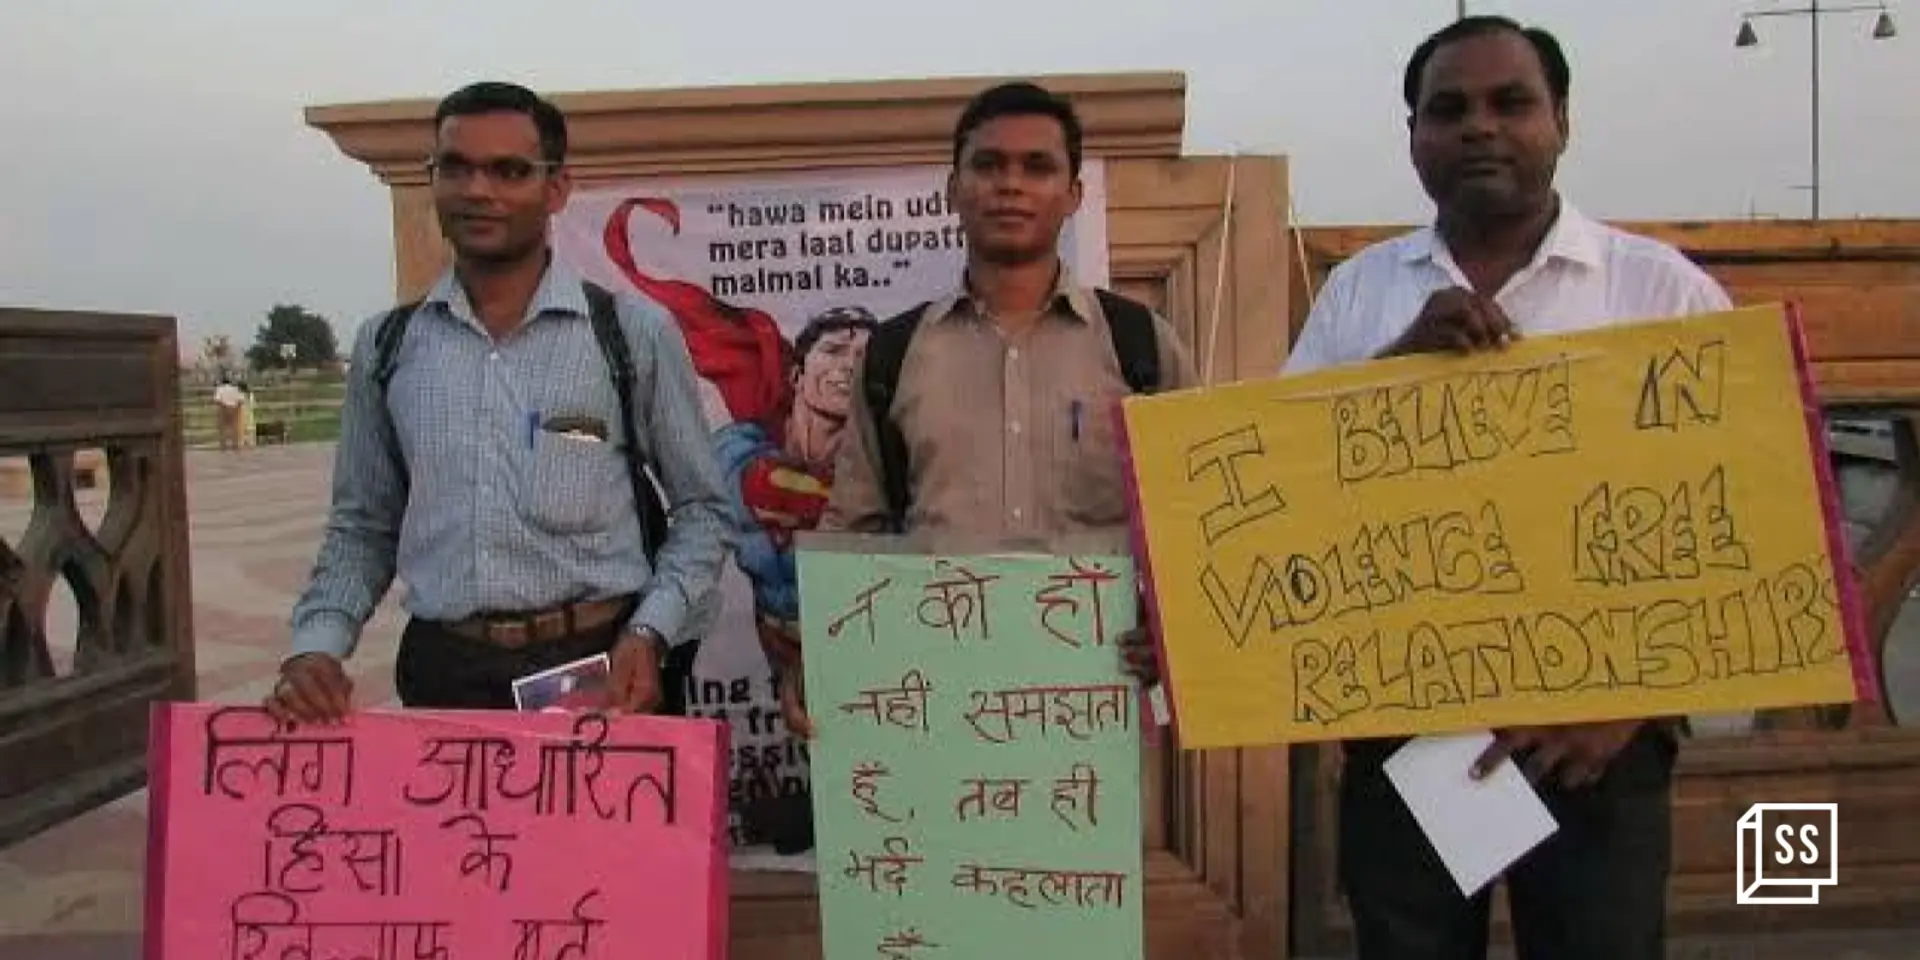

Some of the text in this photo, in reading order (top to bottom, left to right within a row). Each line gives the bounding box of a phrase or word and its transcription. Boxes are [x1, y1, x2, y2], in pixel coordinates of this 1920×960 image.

[819, 194, 893, 222] mein
[709, 237, 788, 262] mera
[801, 229, 854, 257] laal
[711, 264, 823, 296] malmal
[1189, 340, 1725, 546] I BELIEVE IN
[1199, 462, 1751, 648] VIOLENCE FREE
[916, 560, 1000, 641] को
[839, 669, 933, 732] नहीं
[204, 706, 676, 824] लिंग आधारित
[957, 776, 1031, 822] तब
[1051, 763, 1103, 831] ही
[440, 815, 517, 890] के
